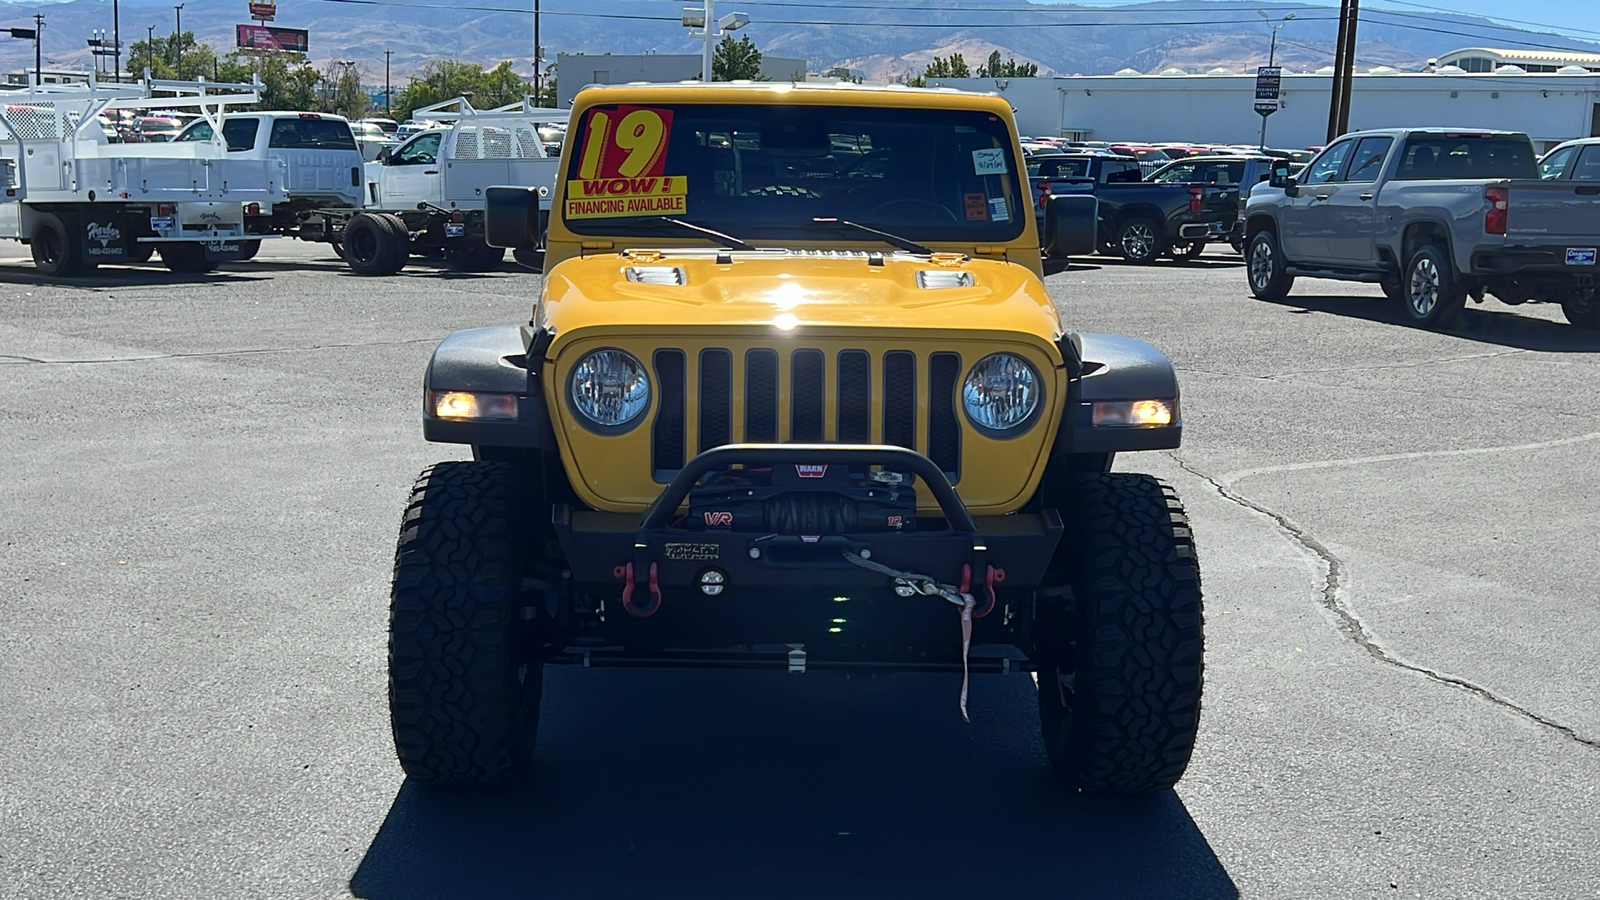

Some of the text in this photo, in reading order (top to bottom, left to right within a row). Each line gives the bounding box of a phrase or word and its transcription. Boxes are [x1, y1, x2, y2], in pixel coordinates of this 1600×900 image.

[580, 109, 664, 179] 19
[583, 179, 658, 196] WOW
[569, 197, 683, 215] FINANCING AVAILABLE
[87, 222, 121, 240] Harbor
[704, 511, 733, 526] VR
